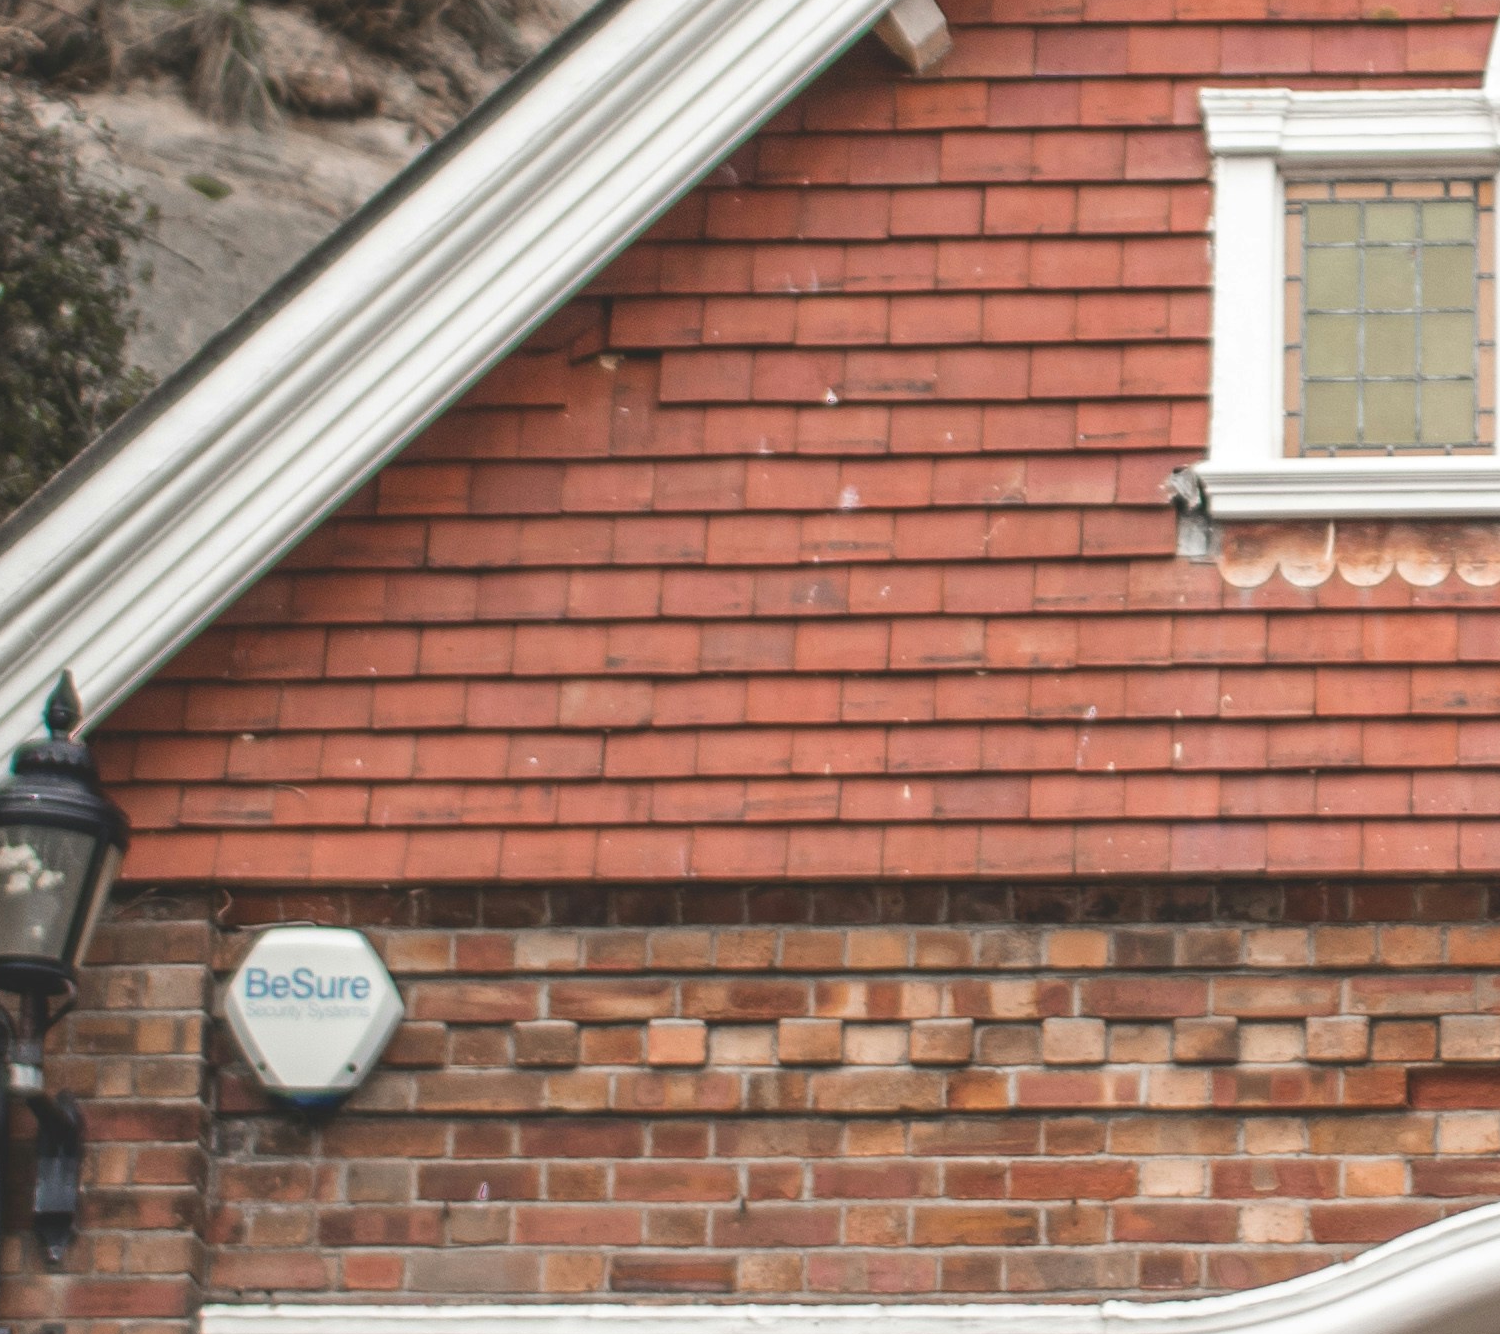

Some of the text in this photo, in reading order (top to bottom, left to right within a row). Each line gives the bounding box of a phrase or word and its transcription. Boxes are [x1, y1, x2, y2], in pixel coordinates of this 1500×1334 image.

[244, 966, 371, 1000] BeSure
[246, 1003, 370, 1020] Security Systems
